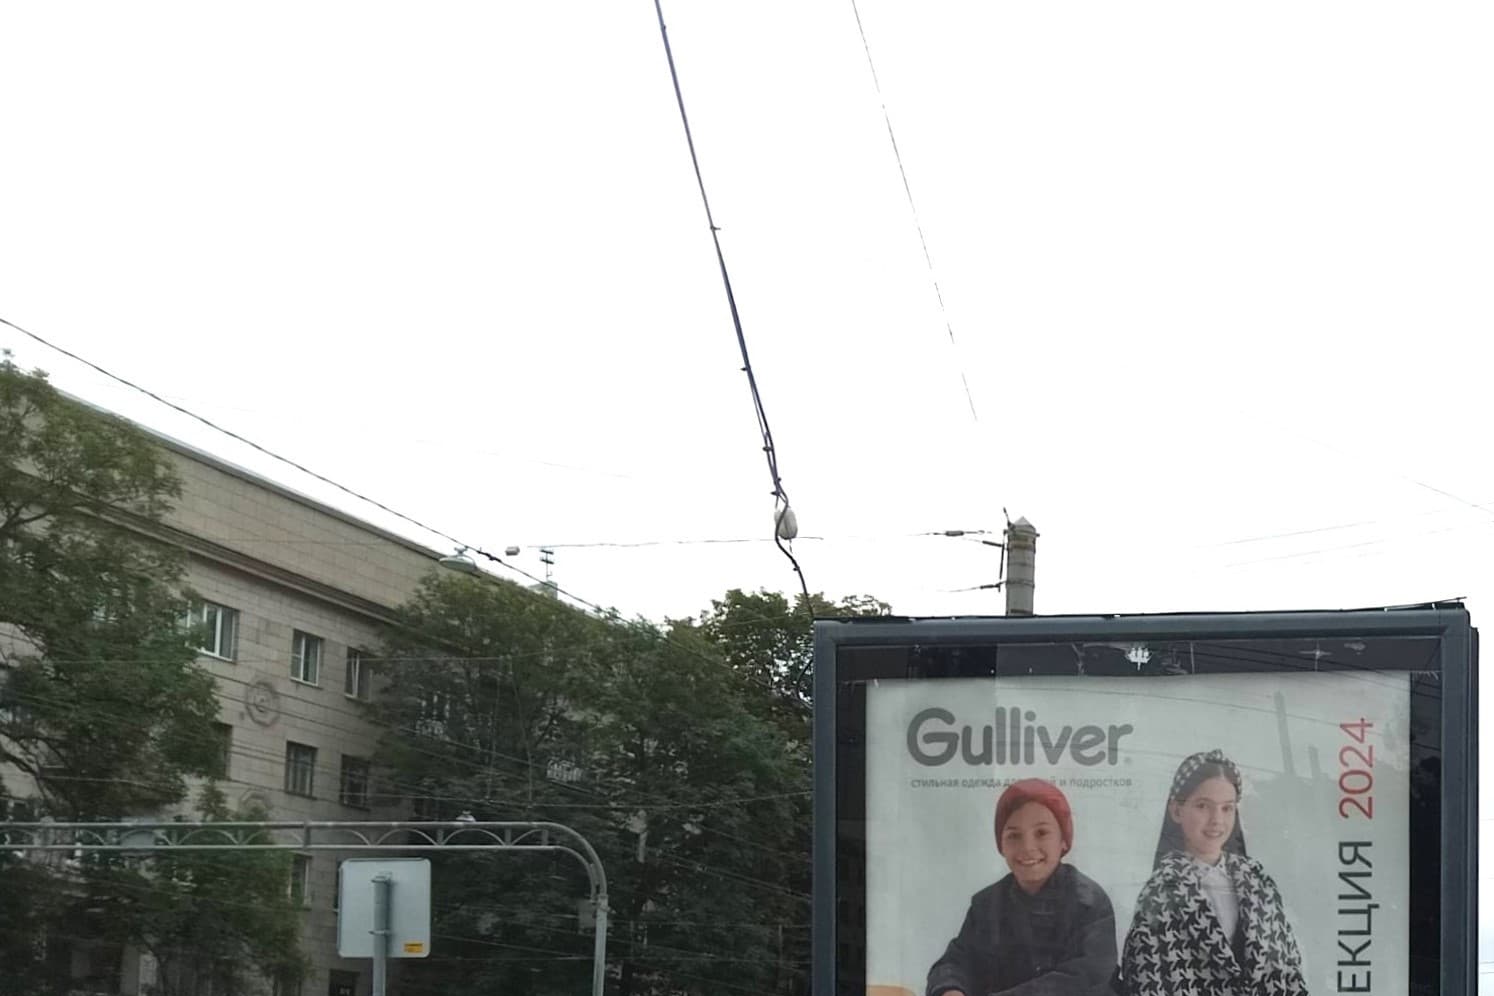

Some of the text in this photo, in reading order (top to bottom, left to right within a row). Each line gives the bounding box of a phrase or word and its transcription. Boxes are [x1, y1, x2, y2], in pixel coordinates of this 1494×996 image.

[906, 706, 1134, 767] Gulliver
[911, 777, 959, 788] стильная
[962, 778, 1000, 789] одежда
[1070, 778, 1132, 789] подростков
[1339, 717, 1375, 820] 2024
